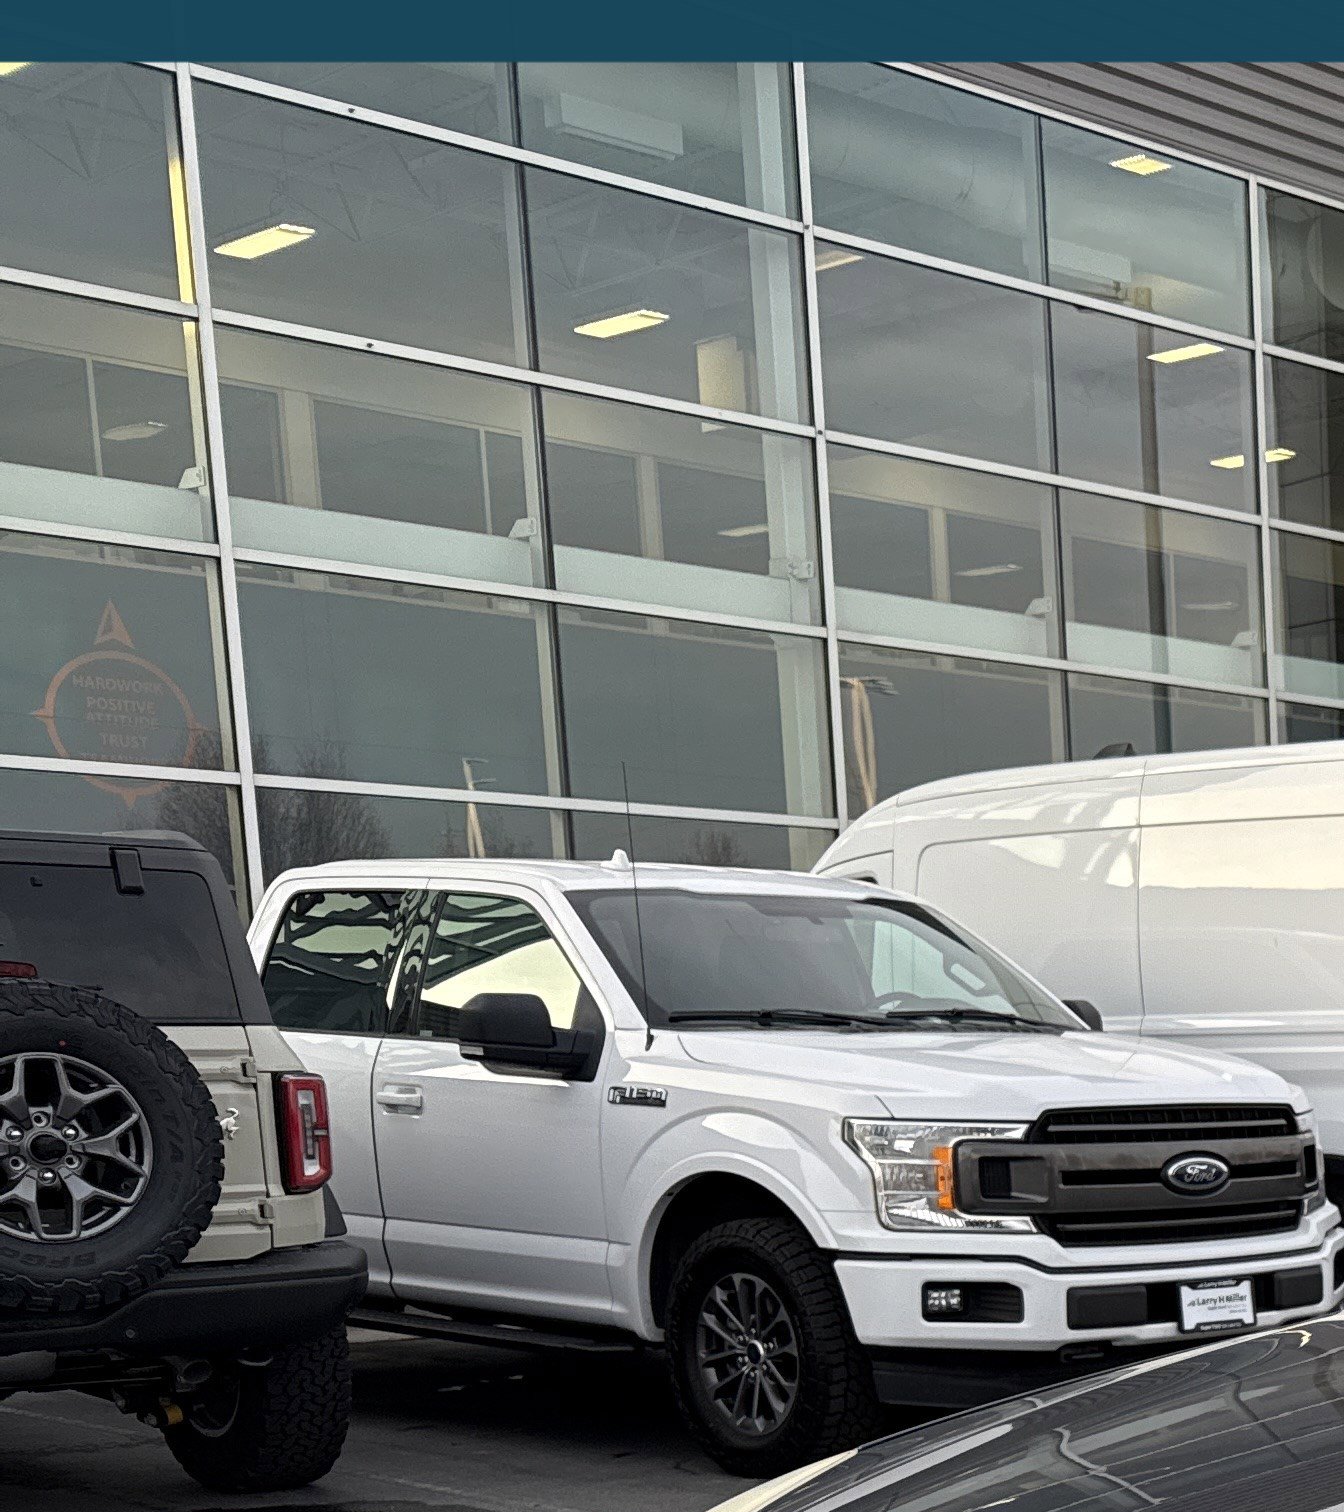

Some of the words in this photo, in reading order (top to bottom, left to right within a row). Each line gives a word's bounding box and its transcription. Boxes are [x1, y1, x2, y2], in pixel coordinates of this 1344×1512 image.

[72, 674, 167, 697] HARDWORK
[86, 696, 157, 716] POSITIVE
[86, 711, 160, 731] ATTITUDE
[101, 731, 148, 750] TRUST
